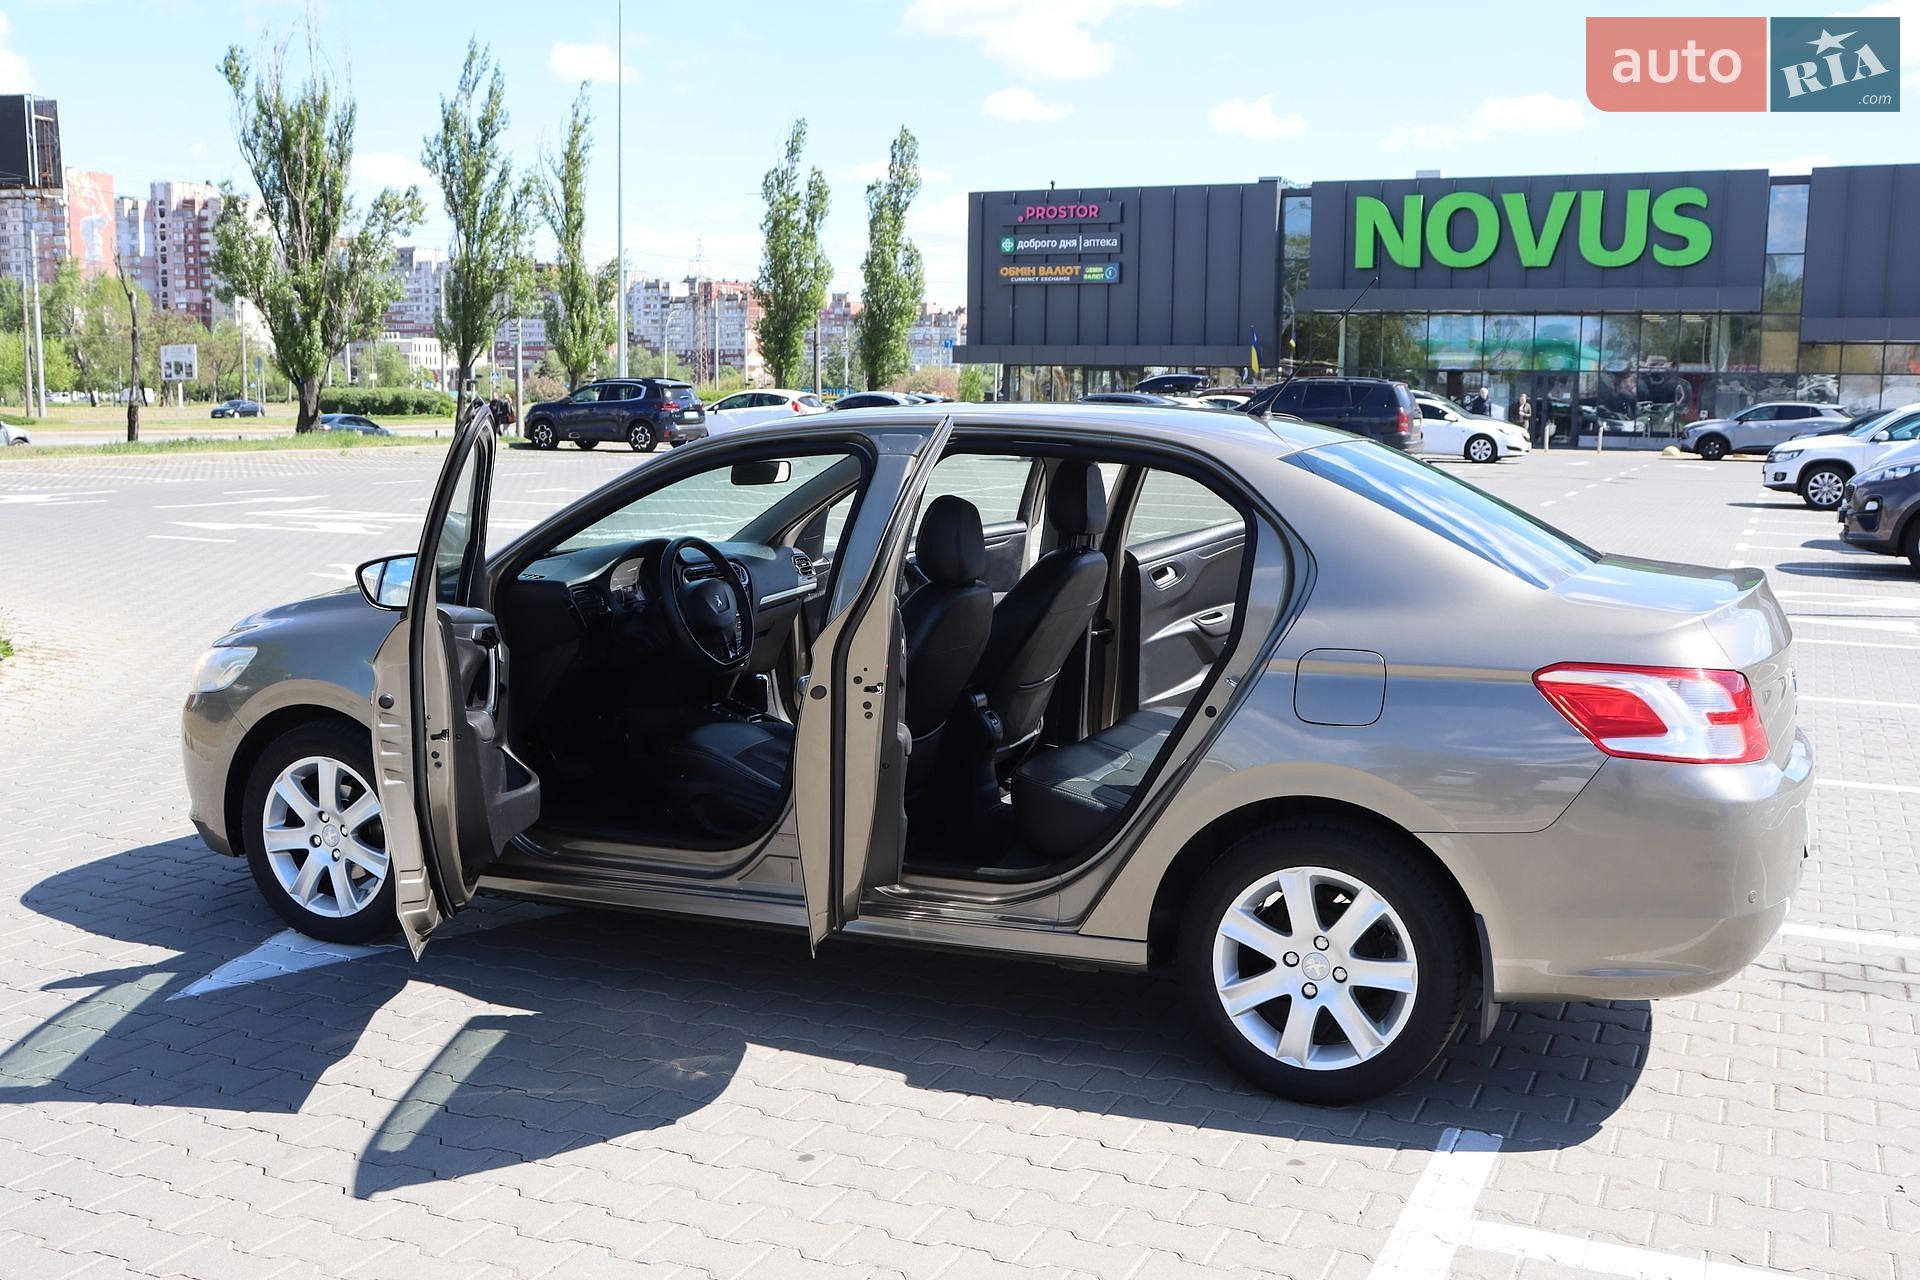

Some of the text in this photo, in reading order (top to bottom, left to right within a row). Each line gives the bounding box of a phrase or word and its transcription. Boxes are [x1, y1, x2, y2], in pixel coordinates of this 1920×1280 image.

[1355, 186, 1713, 269] NOVUS
[1017, 237, 1118, 251] доброго дня аптека
[1000, 265, 1082, 277] ОБМІН ВАЛЮТ
